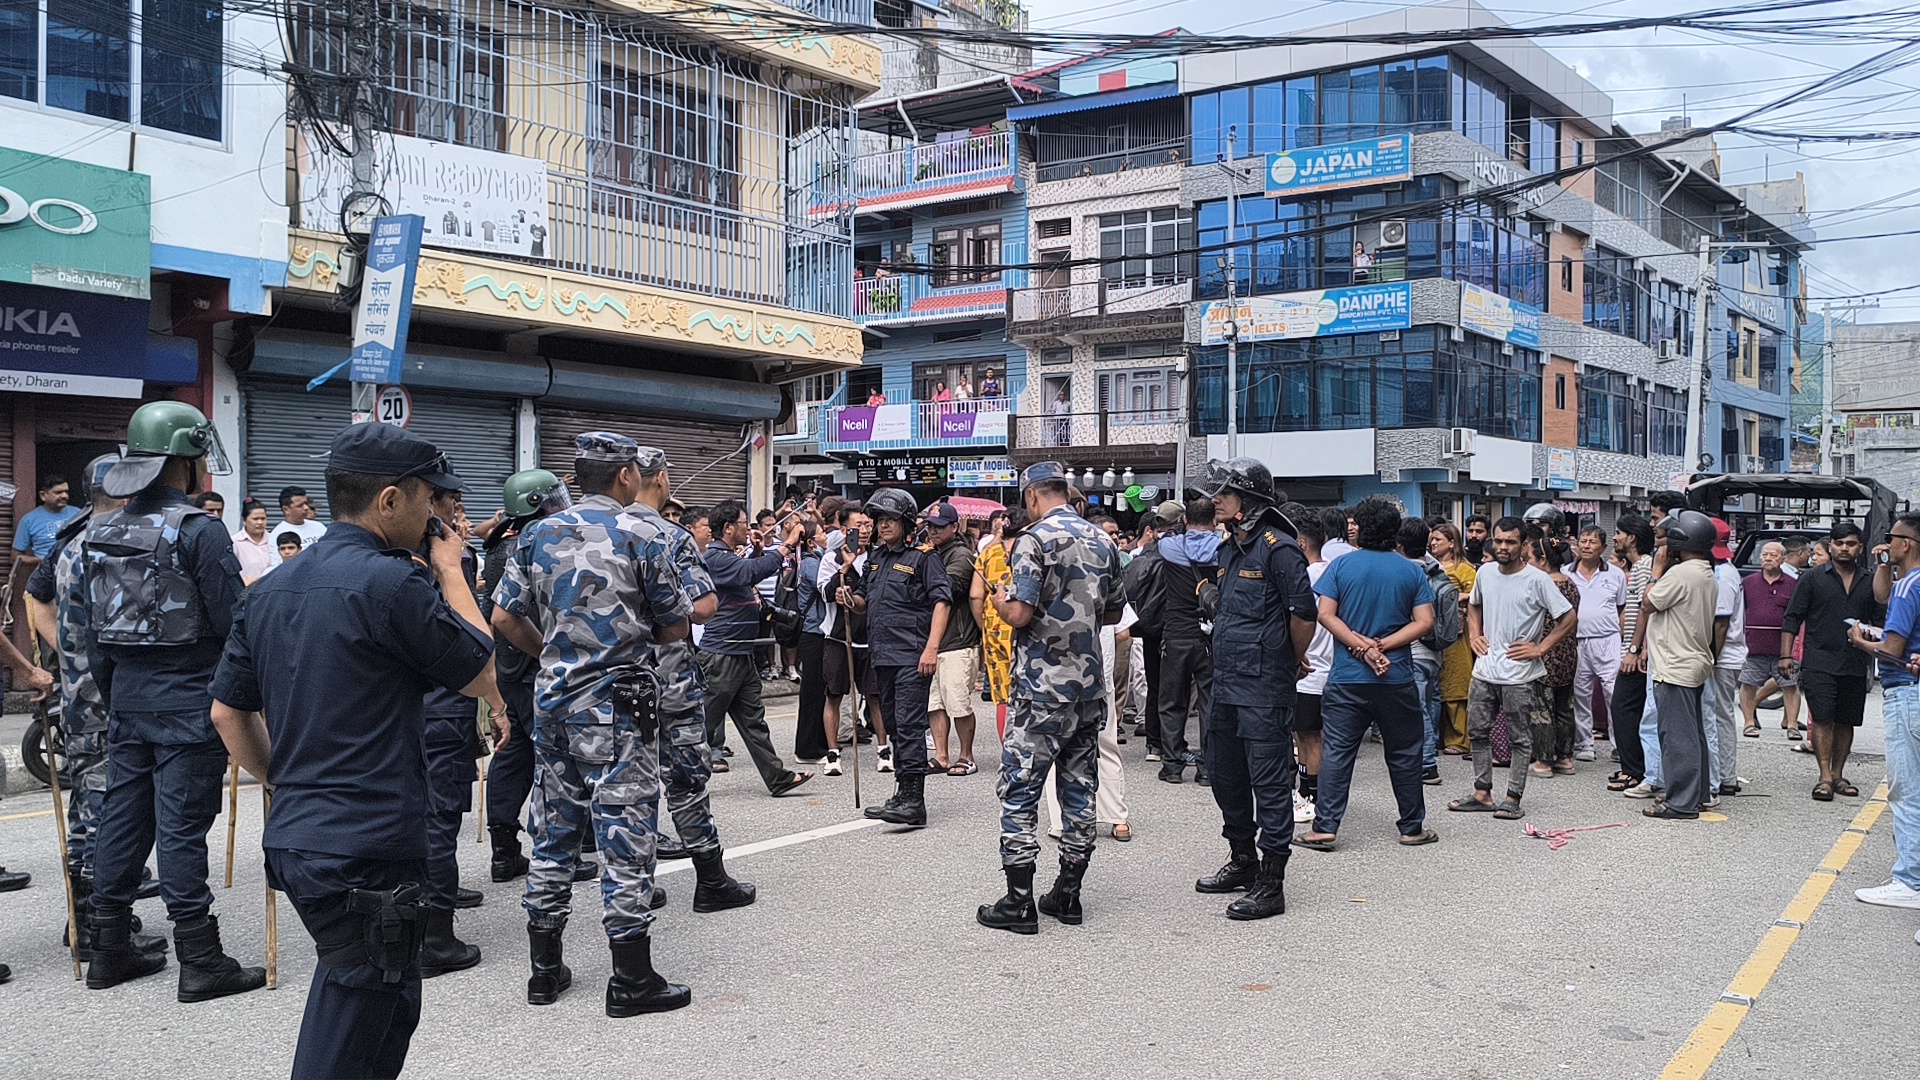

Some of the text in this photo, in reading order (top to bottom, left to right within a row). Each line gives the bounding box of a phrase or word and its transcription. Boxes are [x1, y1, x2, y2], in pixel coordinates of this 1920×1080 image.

[1300, 150, 1373, 176] JAPAN
[1474, 151, 1508, 186] HASTA
[435, 160, 543, 204] READYMADE
[422, 194, 456, 205] Dharan-2
[58, 272, 122, 291] Dadu Variety
[371, 277, 392, 297] सेल्स
[1339, 291, 1407, 312] DANPHE
[0, 306, 81, 338] KIA
[1255, 323, 1286, 333] IELTS
[12, 341, 46, 351] phones
[48, 343, 80, 354] reseller
[26, 375, 68, 388] Dharan
[383, 398, 403, 420] 20
[842, 418, 868, 431] Ncell
[943, 420, 971, 432] Ncell
[915, 457, 946, 465] CENTER
[949, 461, 982, 471] SAUGAT
